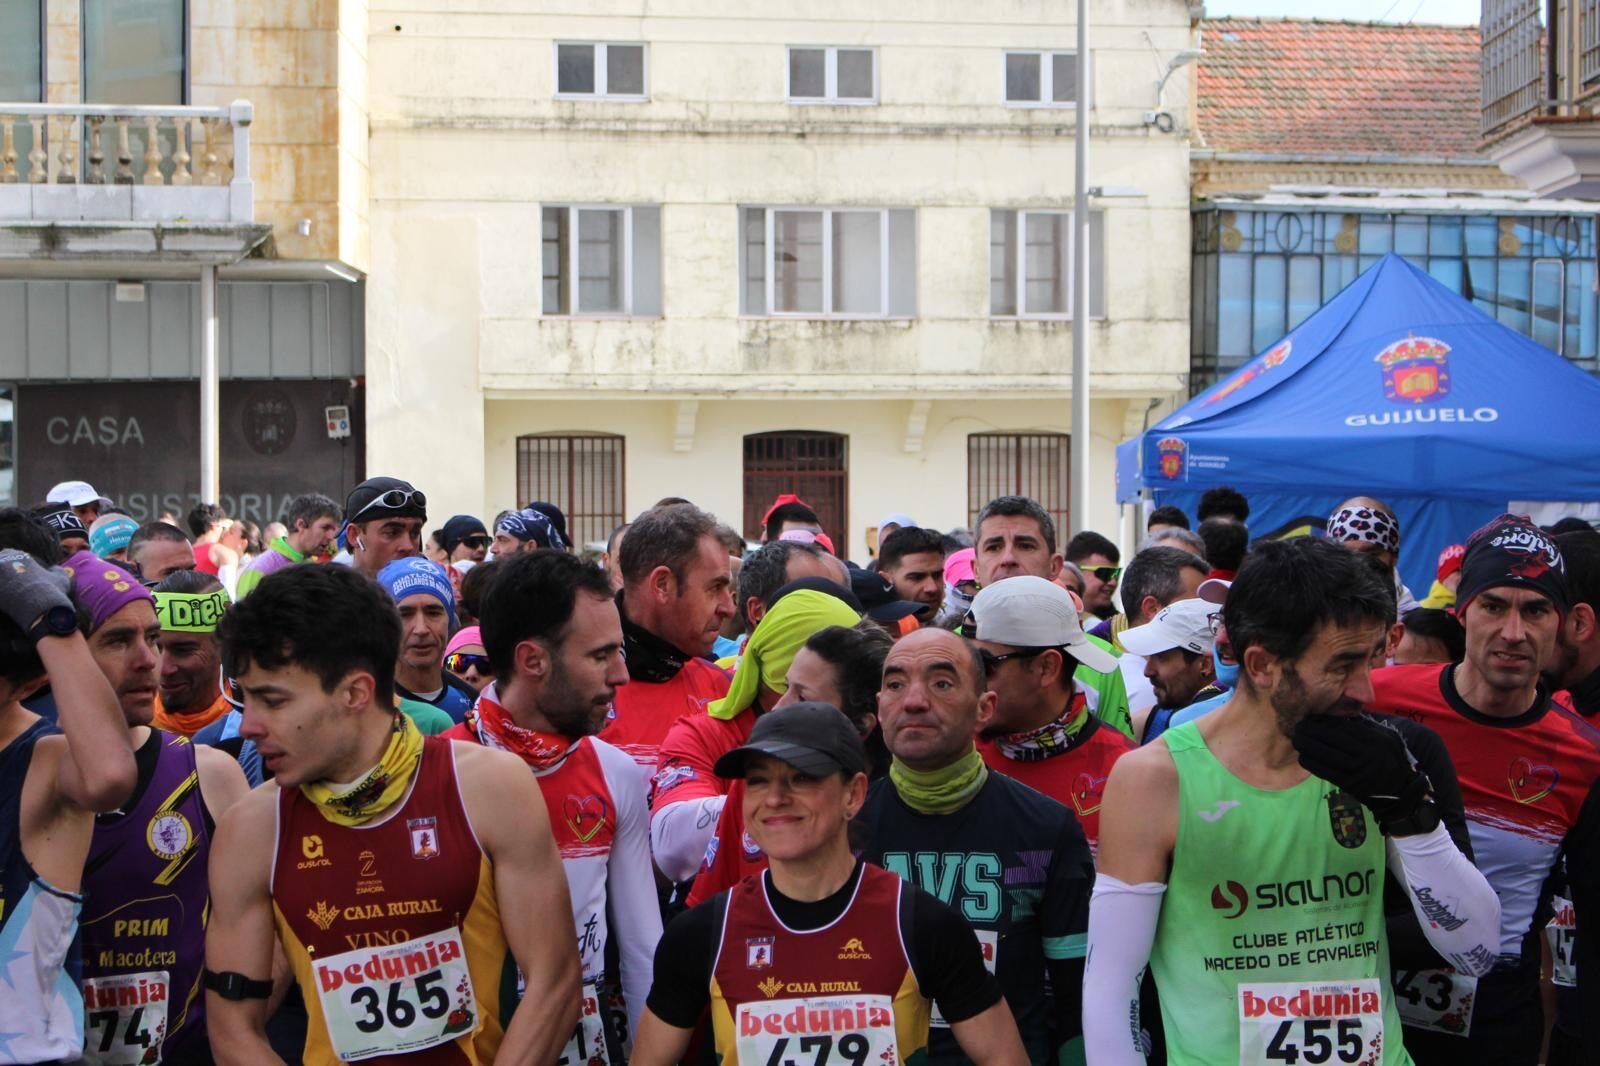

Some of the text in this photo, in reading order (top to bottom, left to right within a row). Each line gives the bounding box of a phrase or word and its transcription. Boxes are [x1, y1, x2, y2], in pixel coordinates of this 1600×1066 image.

[46, 416, 144, 444] CASA
[1345, 407, 1499, 427] GUIJUELO
[343, 899, 443, 921] CAJA RURAL
[114, 917, 170, 938] PRIM
[345, 928, 411, 950] VINO
[1232, 921, 1365, 950] CLUBE ATLÉTICO
[99, 948, 177, 968] Macotera
[318, 939, 462, 993] bedunia
[1203, 954, 1271, 972] MACEDO
[1278, 952, 1301, 968] DE
[350, 969, 451, 1034] 365
[786, 980, 862, 994] CAJA RURAL
[1396, 968, 1454, 1012] 43
[1243, 987, 1380, 1018] bedunia
[86, 1007, 152, 1053] 74
[740, 1001, 892, 1038] bedunia
[765, 1033, 870, 1066] 479
[1265, 1018, 1364, 1065] 455
